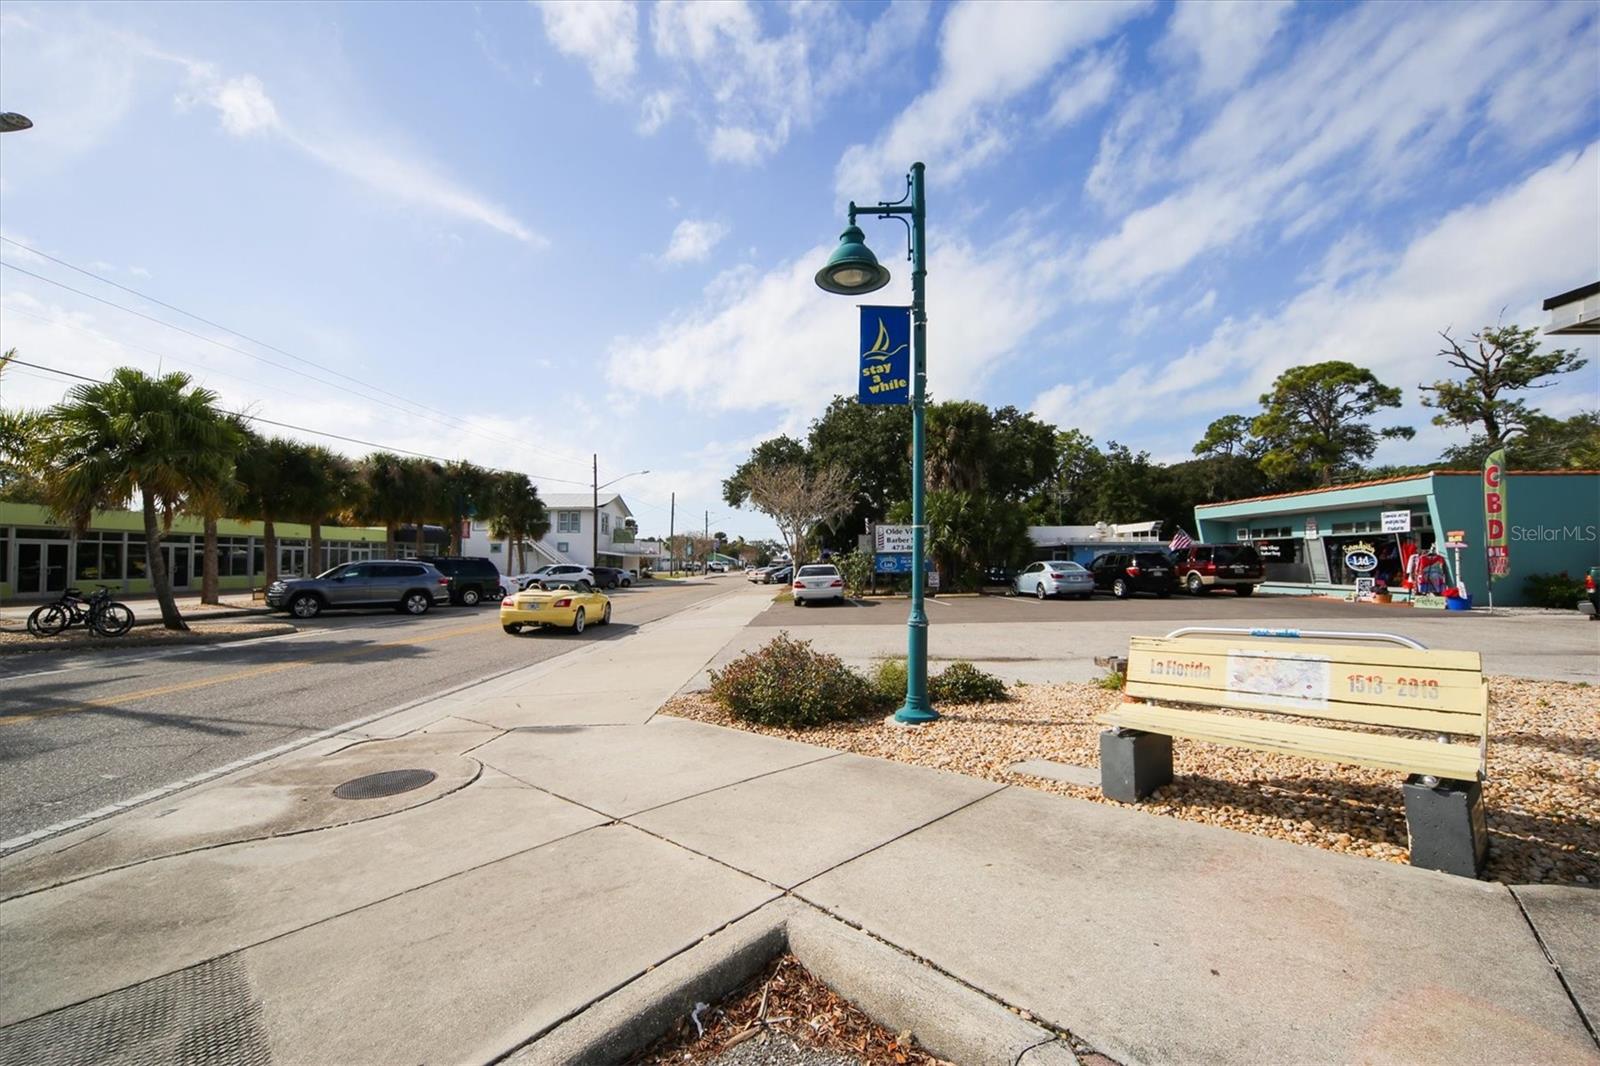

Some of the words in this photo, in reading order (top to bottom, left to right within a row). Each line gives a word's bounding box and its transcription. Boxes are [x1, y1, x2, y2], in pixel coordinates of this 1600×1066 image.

[863, 363, 891, 376] stay
[868, 378, 907, 394] while
[872, 374, 882, 383] a
[1486, 465, 1504, 540] CBD
[1150, 658, 1163, 674] La
[1166, 660, 1210, 678] Florida
